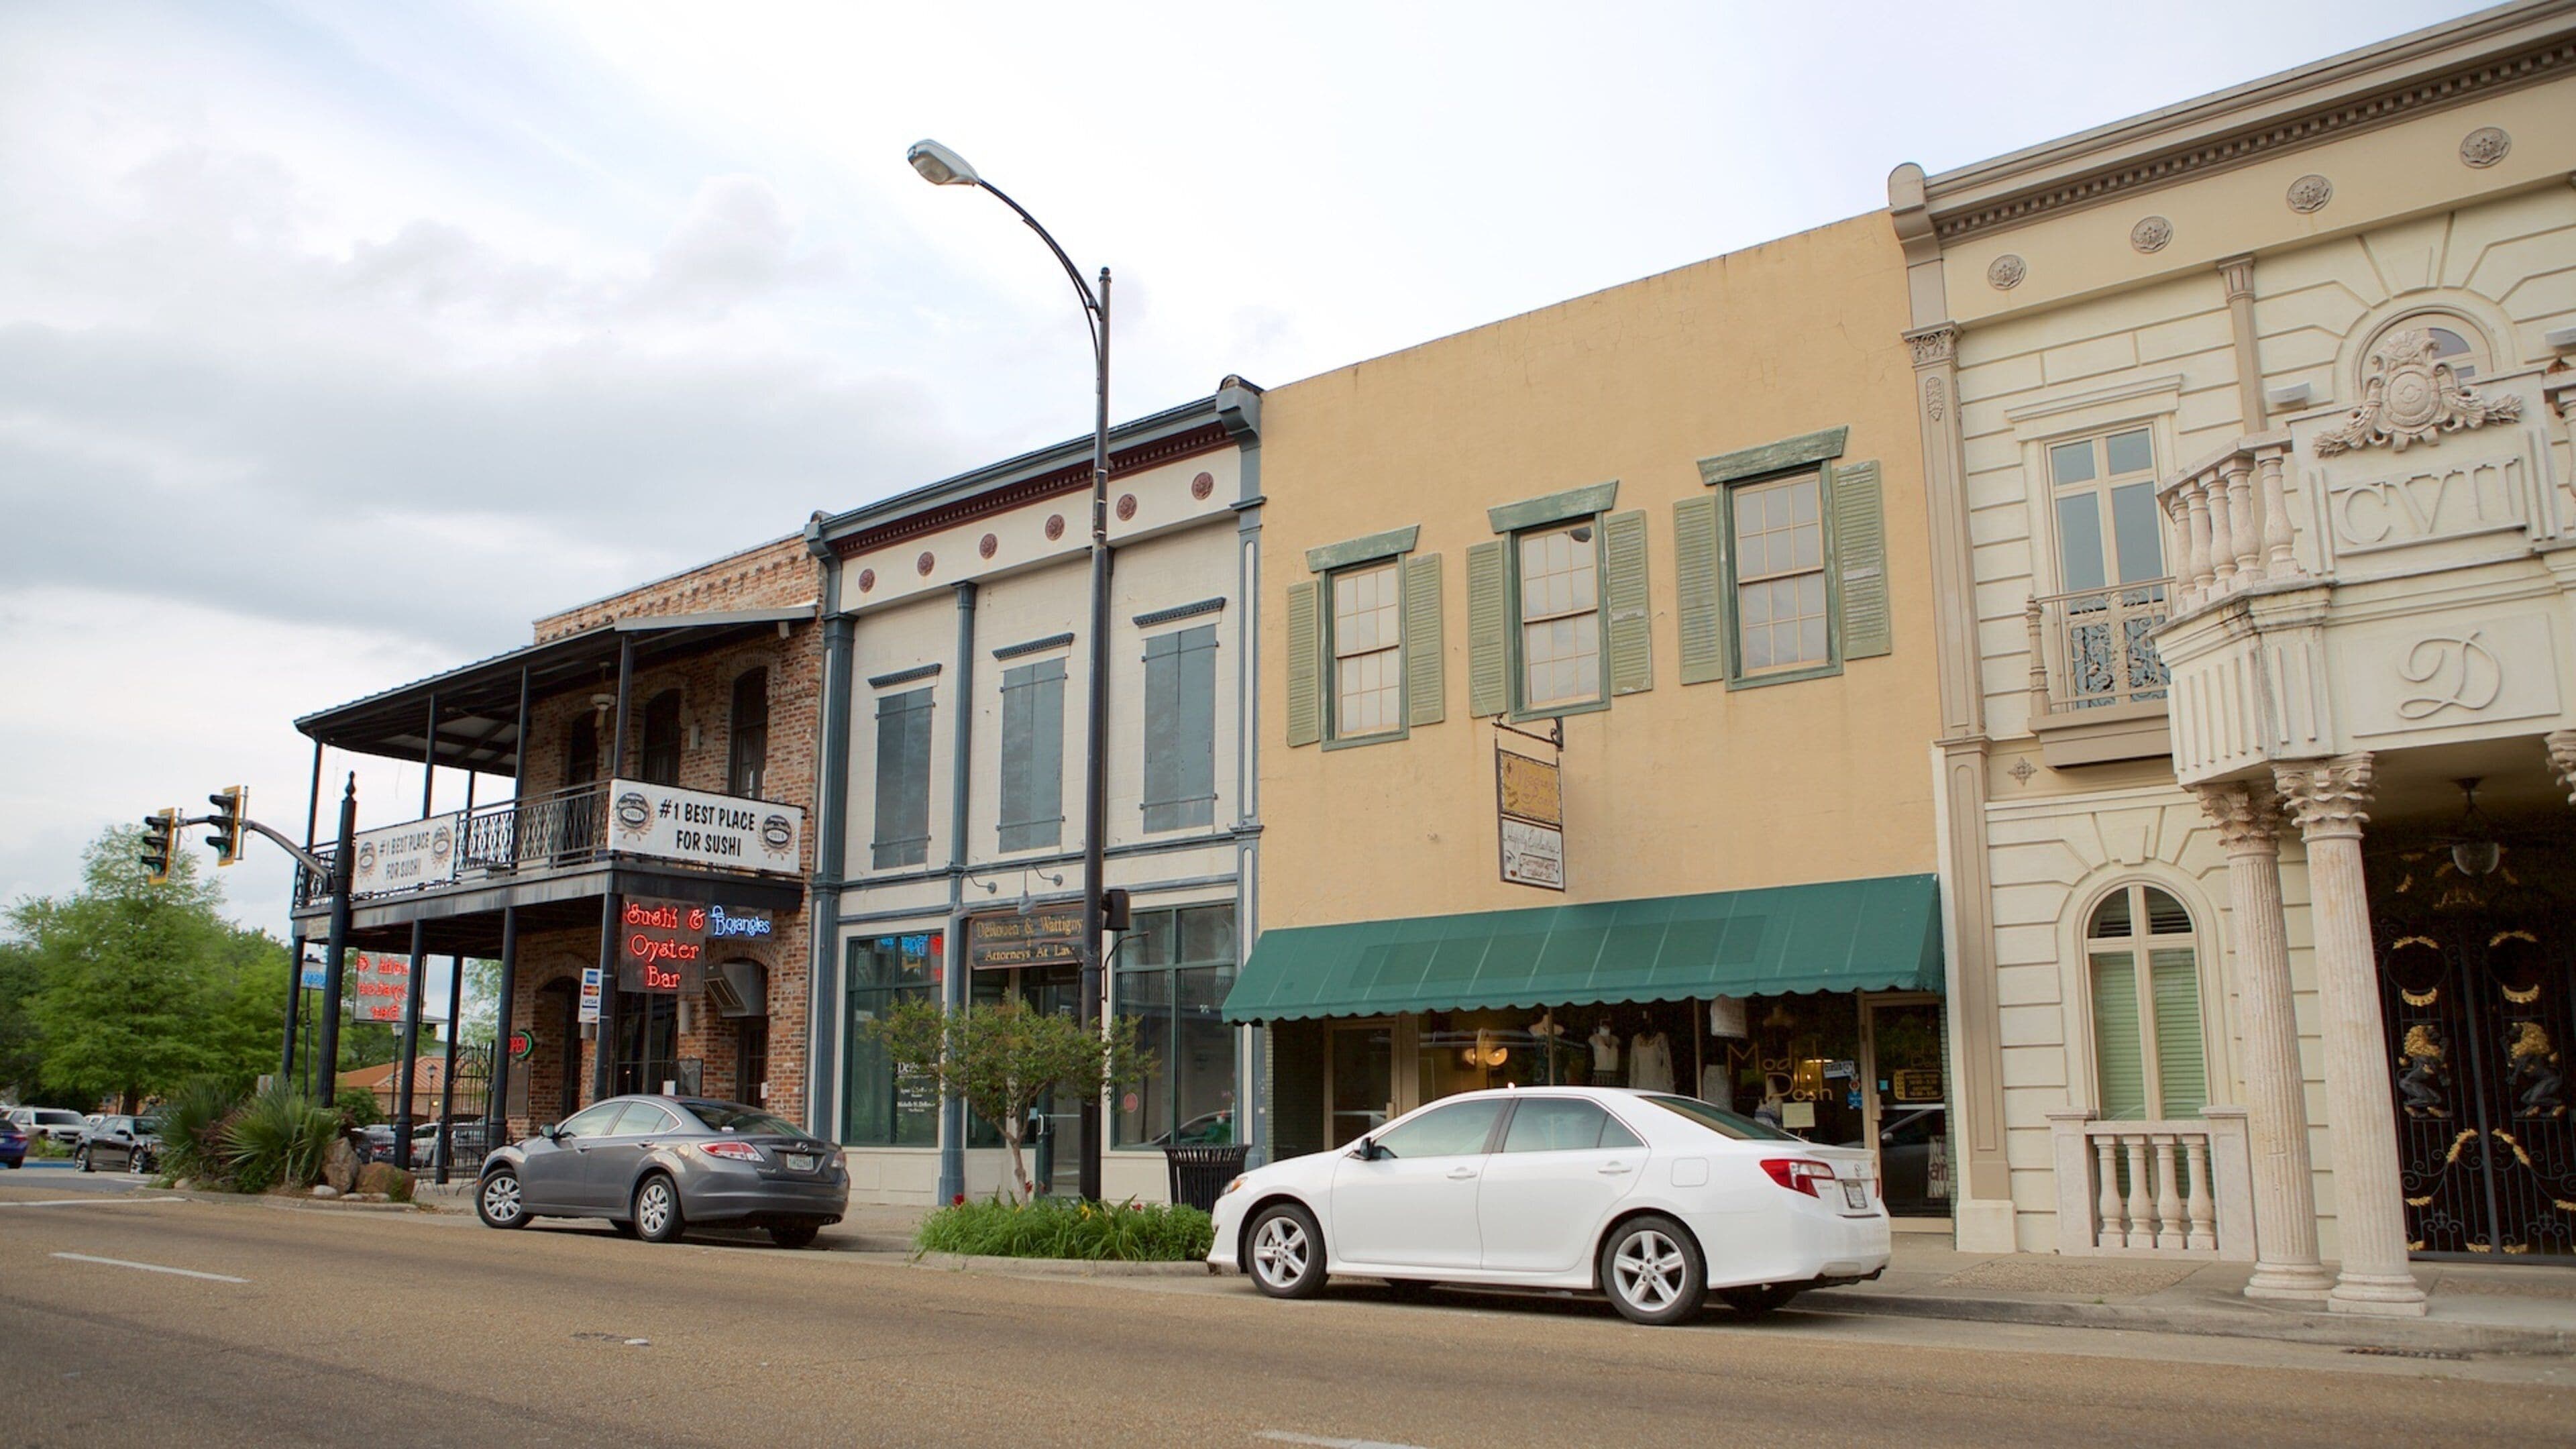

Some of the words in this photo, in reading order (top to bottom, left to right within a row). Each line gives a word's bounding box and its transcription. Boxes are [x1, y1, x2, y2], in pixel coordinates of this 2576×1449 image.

[2336, 460, 2520, 545] CVII
[2397, 631, 2502, 719] D
[659, 798, 679, 822] #1
[684, 803, 714, 826] BEST
[718, 810, 755, 831] PLACE
[379, 839, 389, 857] #1
[391, 835, 407, 855] BEST
[408, 831, 429, 853] PLACE
[676, 830, 700, 851] FOR
[704, 833, 741, 857] SUSHI
[386, 861, 399, 880] FOR
[400, 857, 421, 877] SUSHI
[627, 904, 678, 929] Sushi
[688, 908, 705, 930] &
[1024, 917, 1034, 936] &
[631, 934, 700, 962] Oyster
[985, 949, 1031, 961] Attorneys
[1036, 947, 1048, 958] At
[647, 965, 681, 988] Bar
[1727, 1040, 1792, 1075] Mod
[1764, 1041, 1833, 1104] Posh
